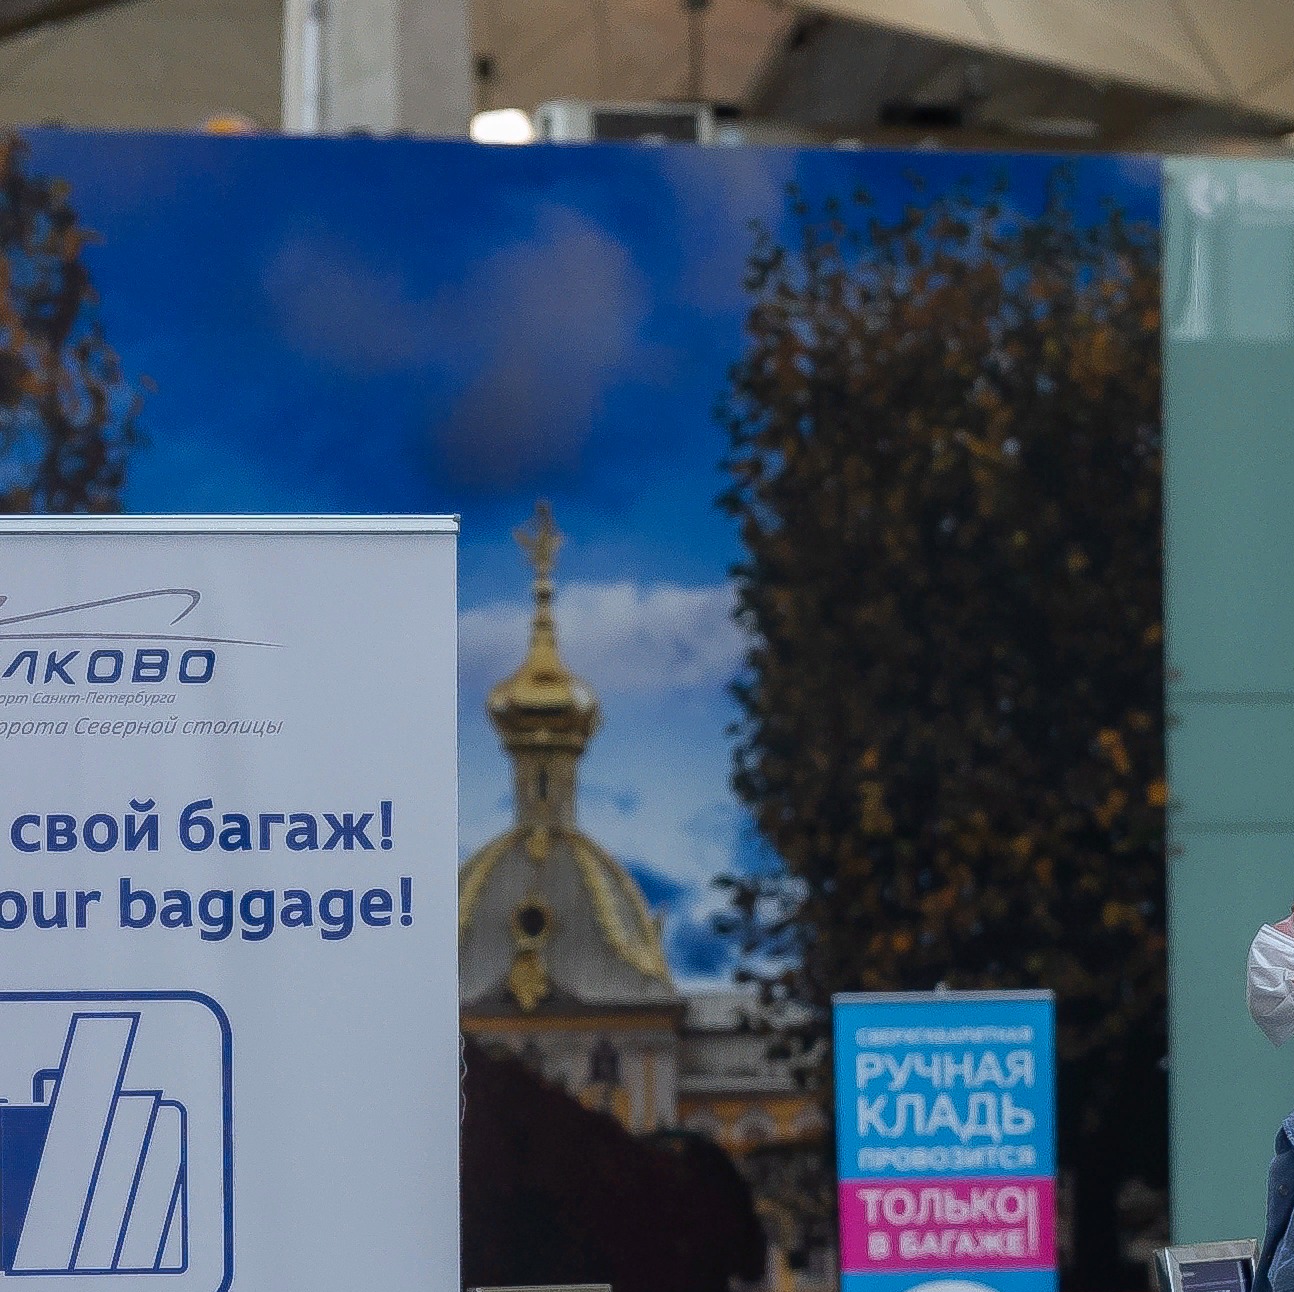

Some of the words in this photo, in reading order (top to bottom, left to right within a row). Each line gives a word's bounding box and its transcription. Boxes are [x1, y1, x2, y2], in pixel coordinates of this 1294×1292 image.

[32, 689, 177, 707] Санкт-Петербурга
[74, 714, 179, 739] Северной
[181, 719, 285, 738] столицы
[10, 798, 161, 853] свой
[178, 798, 395, 852] багаж!
[0, 889, 102, 930] our
[118, 876, 415, 942] baggage!
[855, 1051, 1035, 1090] РУЧНАЯ
[857, 1091, 1036, 1144] КЛАДЬ
[857, 1146, 1037, 1172] ПРОВОЗИТСЯ
[856, 1185, 1028, 1225] ТОЛЬКО
[867, 1230, 891, 1260] В
